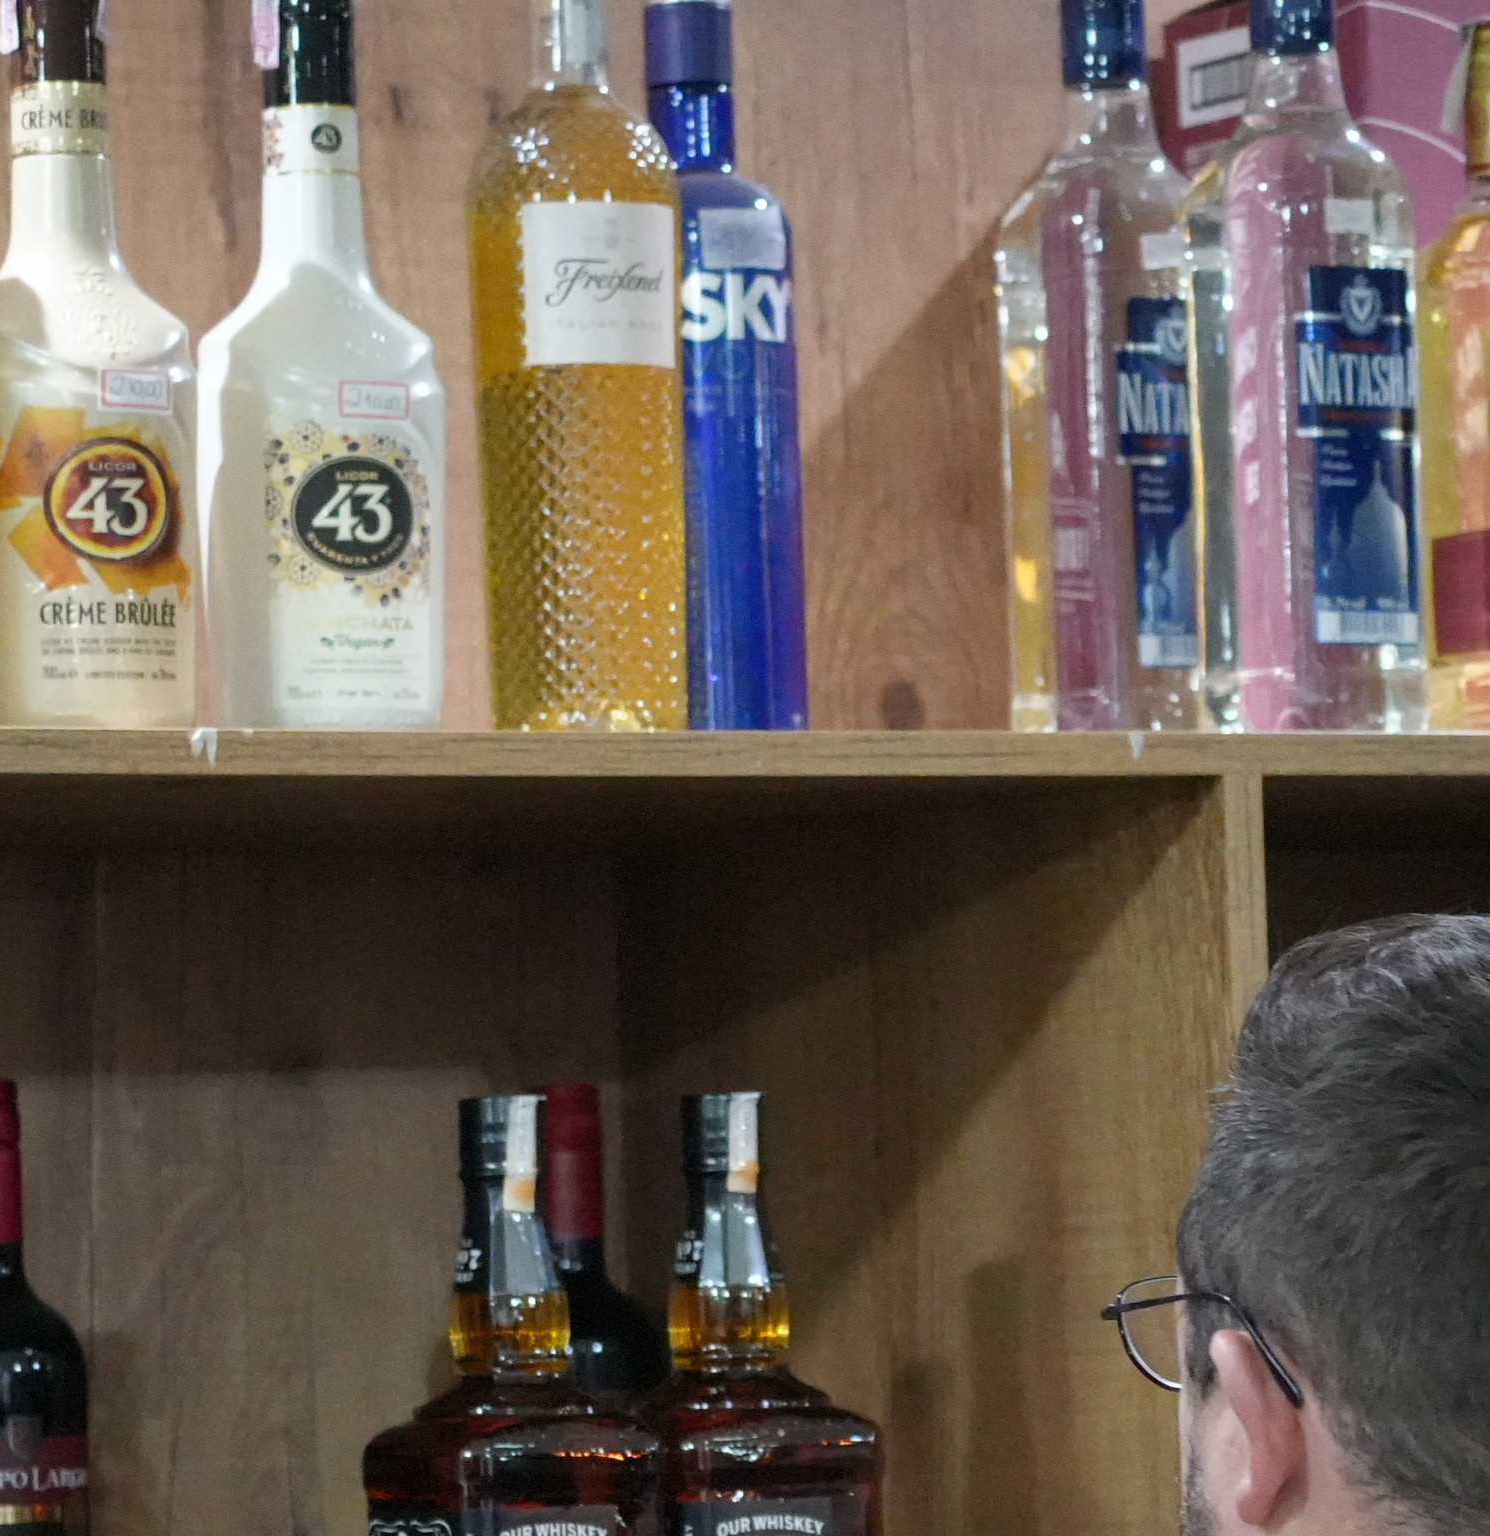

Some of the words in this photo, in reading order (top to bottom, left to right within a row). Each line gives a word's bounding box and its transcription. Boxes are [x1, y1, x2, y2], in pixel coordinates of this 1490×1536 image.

[21, 104, 74, 130] CRÈME
[66, 475, 149, 536] 43
[311, 483, 393, 543] 43
[39, 596, 106, 626] CRÈME
[114, 596, 177, 628] BRÛLÉE
[752, 1516, 824, 1536] WHISKEY
